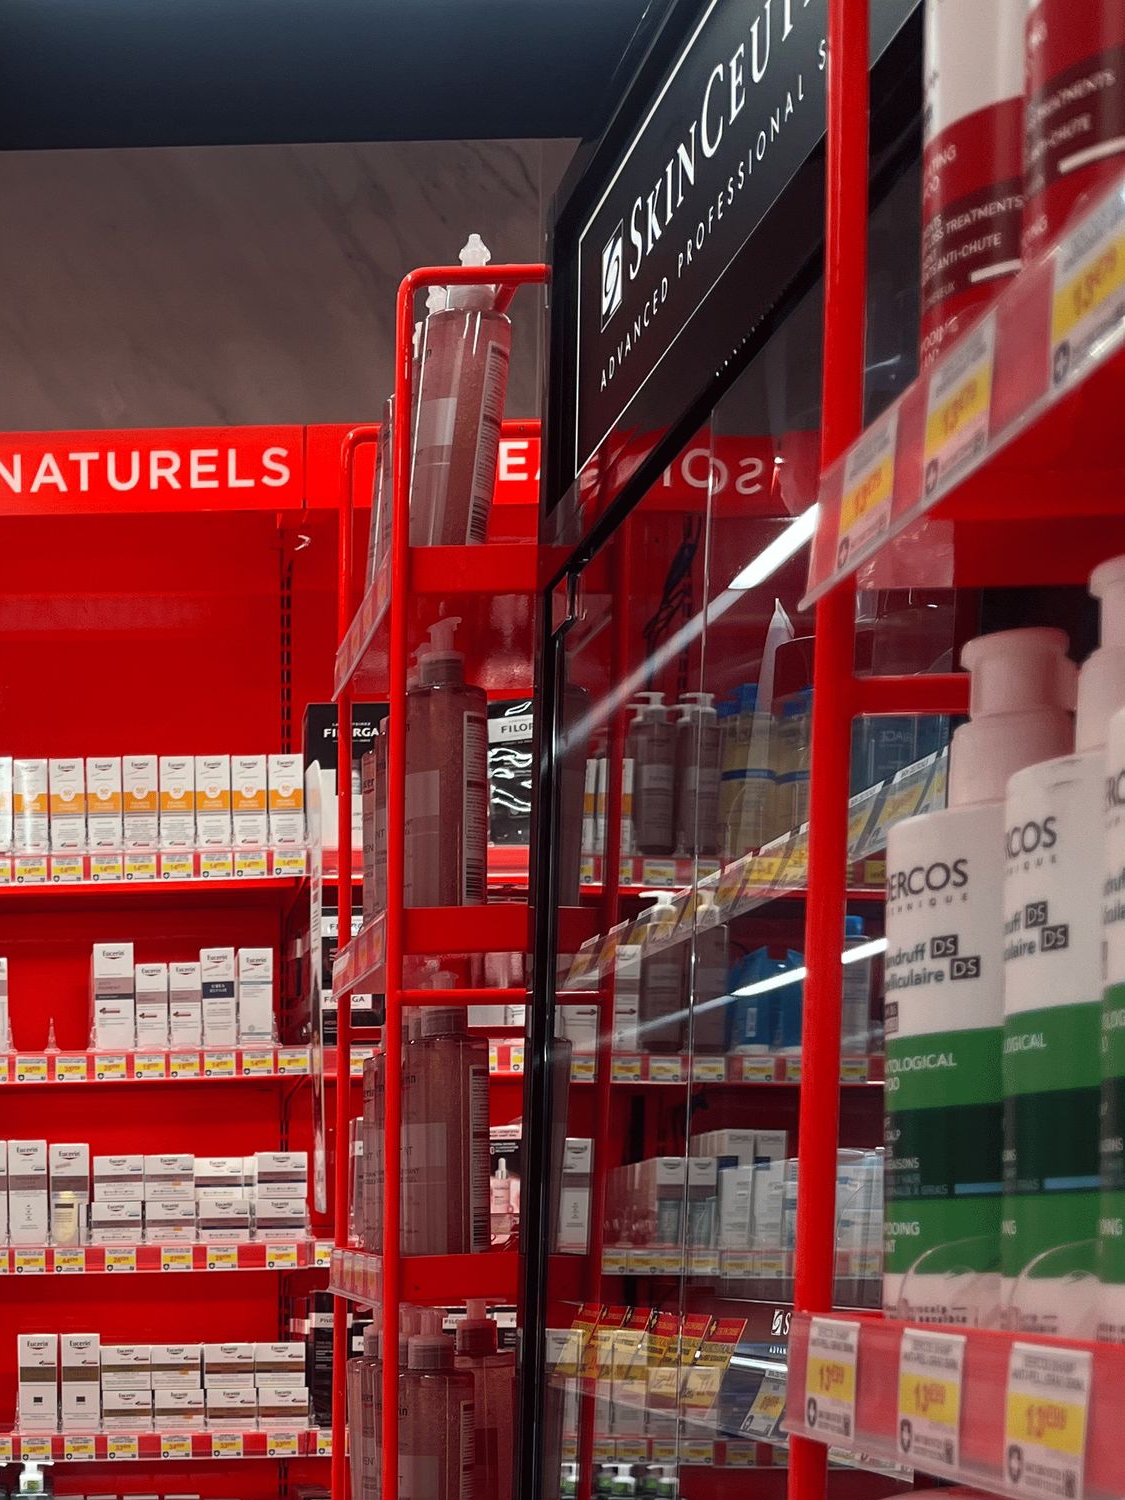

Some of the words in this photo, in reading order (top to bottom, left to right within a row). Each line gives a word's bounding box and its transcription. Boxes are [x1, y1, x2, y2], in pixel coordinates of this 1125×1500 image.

[945, 195, 1025, 234] TREATMENTS
[599, 276, 669, 393] ADVANCED
[677, 74, 805, 278] PROFESSIONAL
[1026, 903, 1047, 925] DS
[934, 936, 957, 956] DS
[1043, 926, 1067, 949] DS
[952, 957, 979, 978] DS
